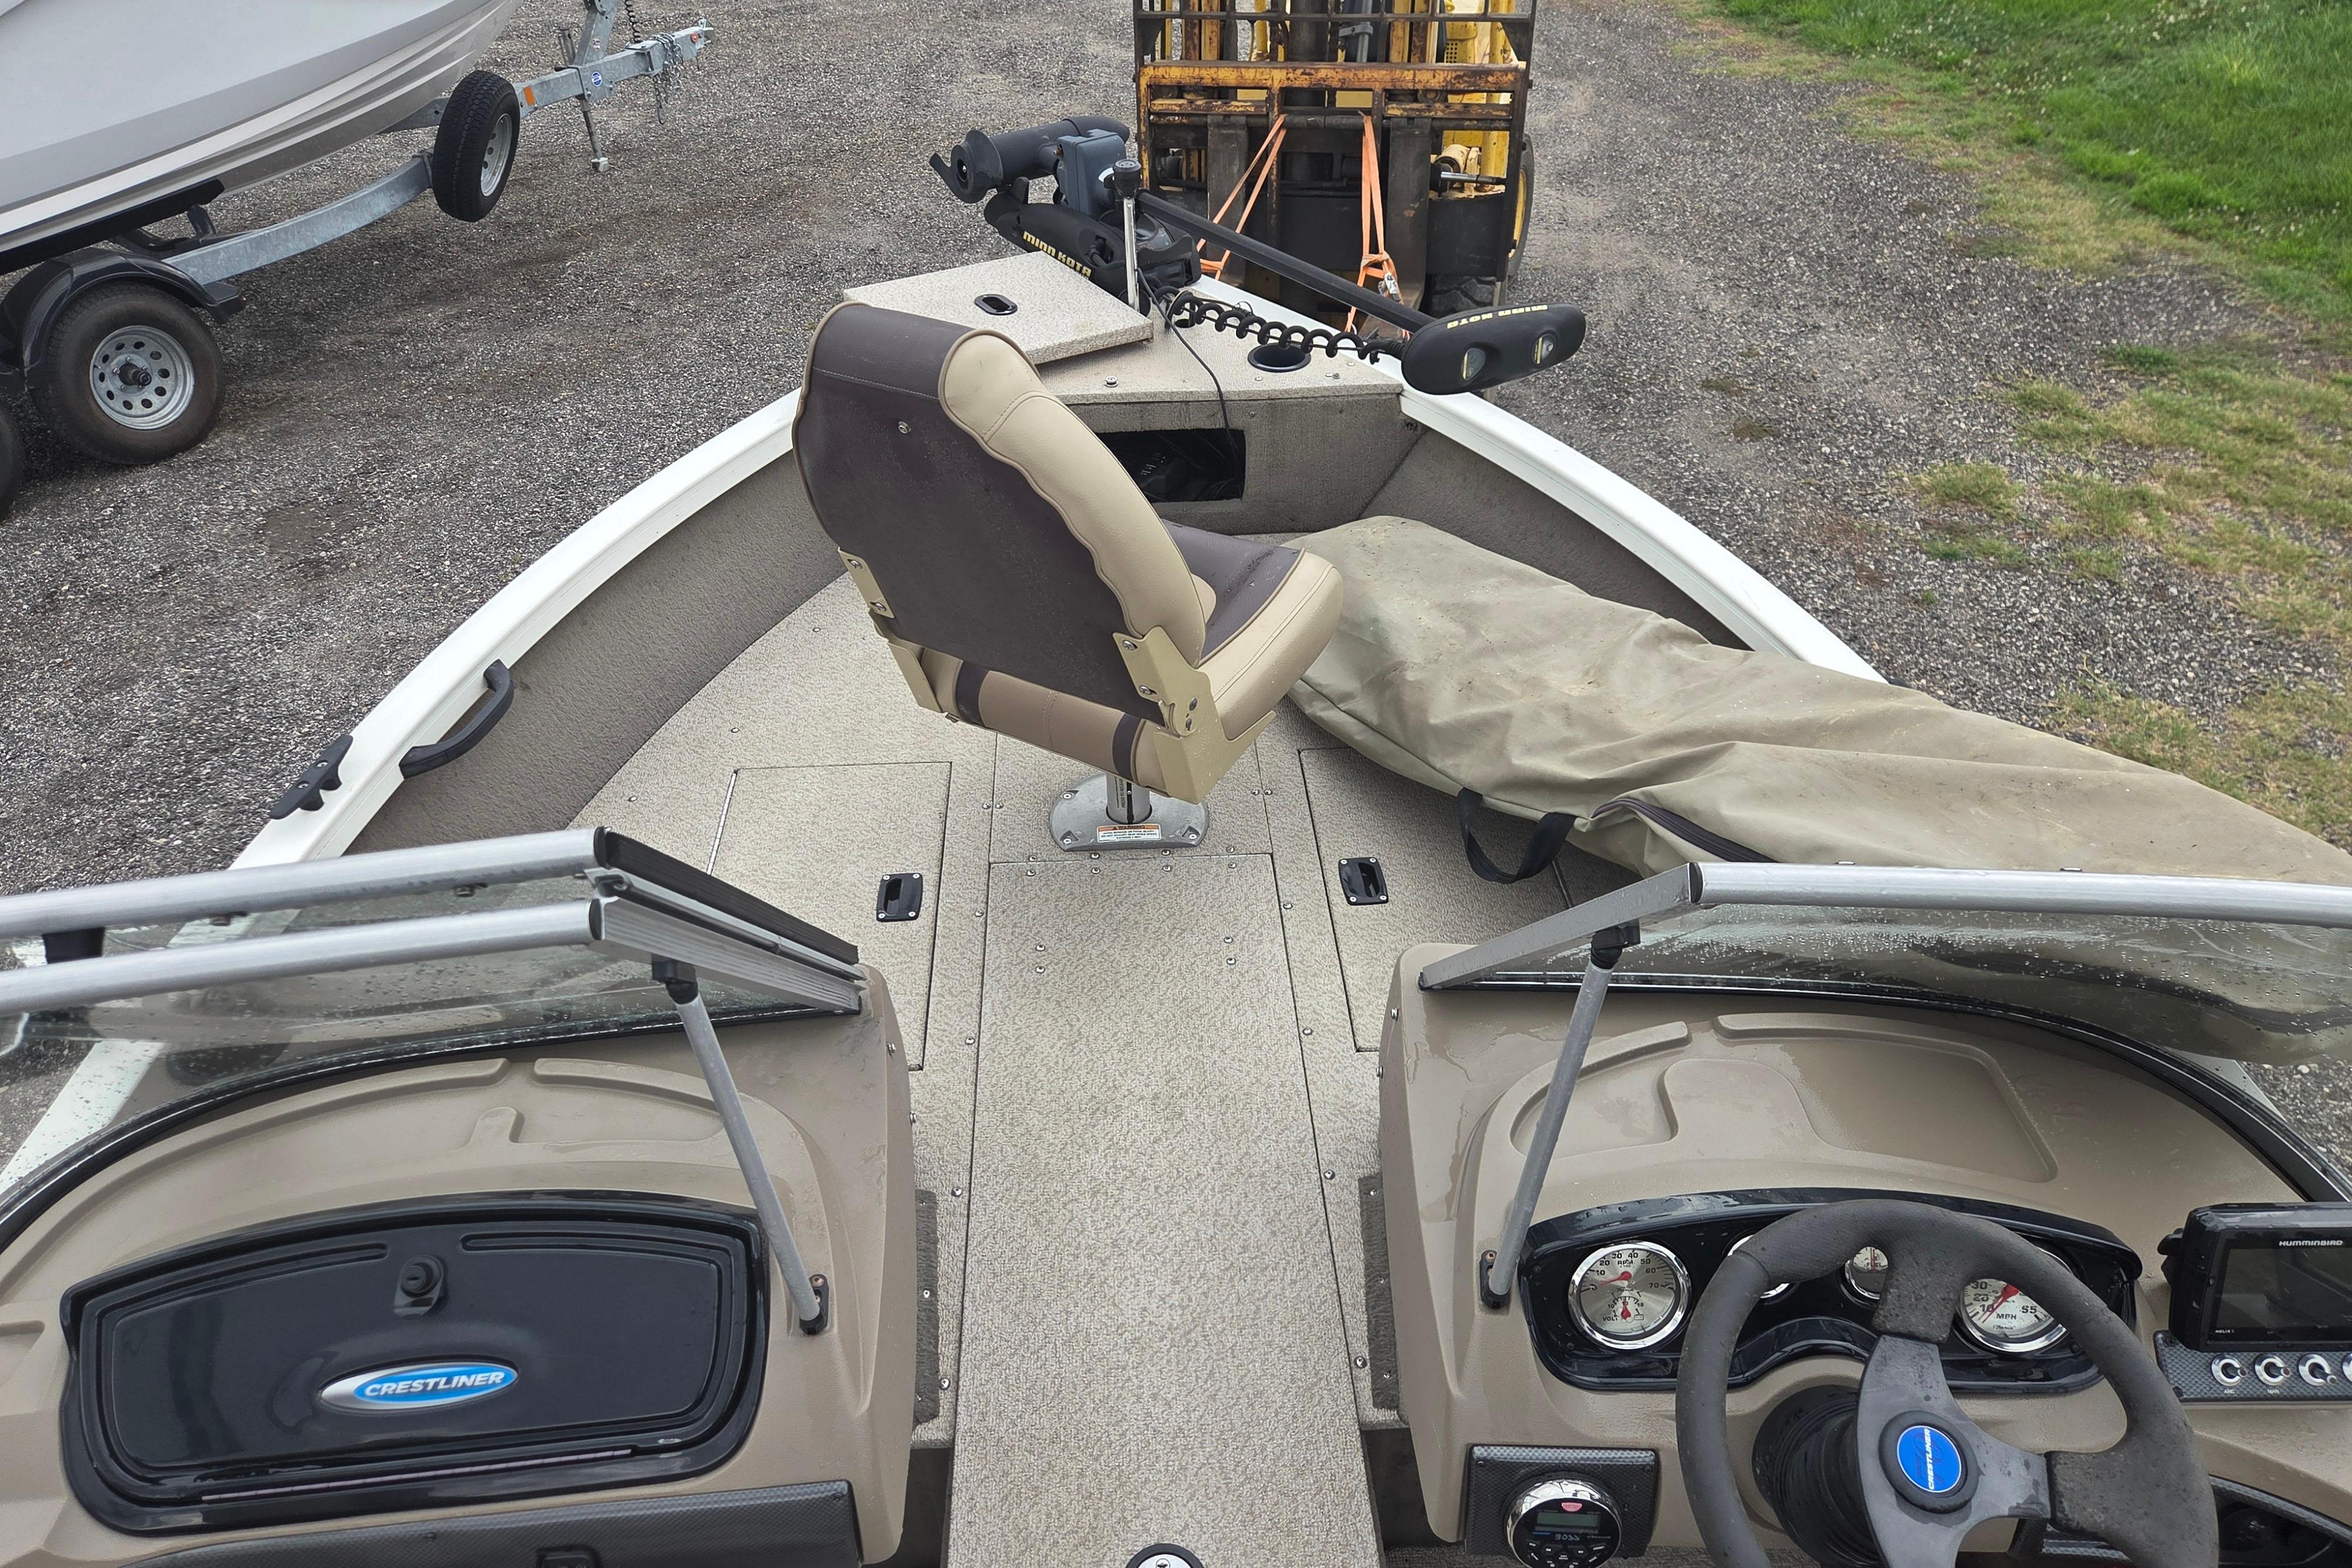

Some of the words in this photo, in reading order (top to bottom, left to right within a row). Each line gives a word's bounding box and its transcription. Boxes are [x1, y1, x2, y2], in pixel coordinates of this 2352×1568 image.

[1057, 251, 1092, 278] KOTA
[1973, 1293, 1989, 1302] 20
[365, 1371, 506, 1396] CRESTLINER
[1924, 1428, 1935, 1490] CRESTLINER
